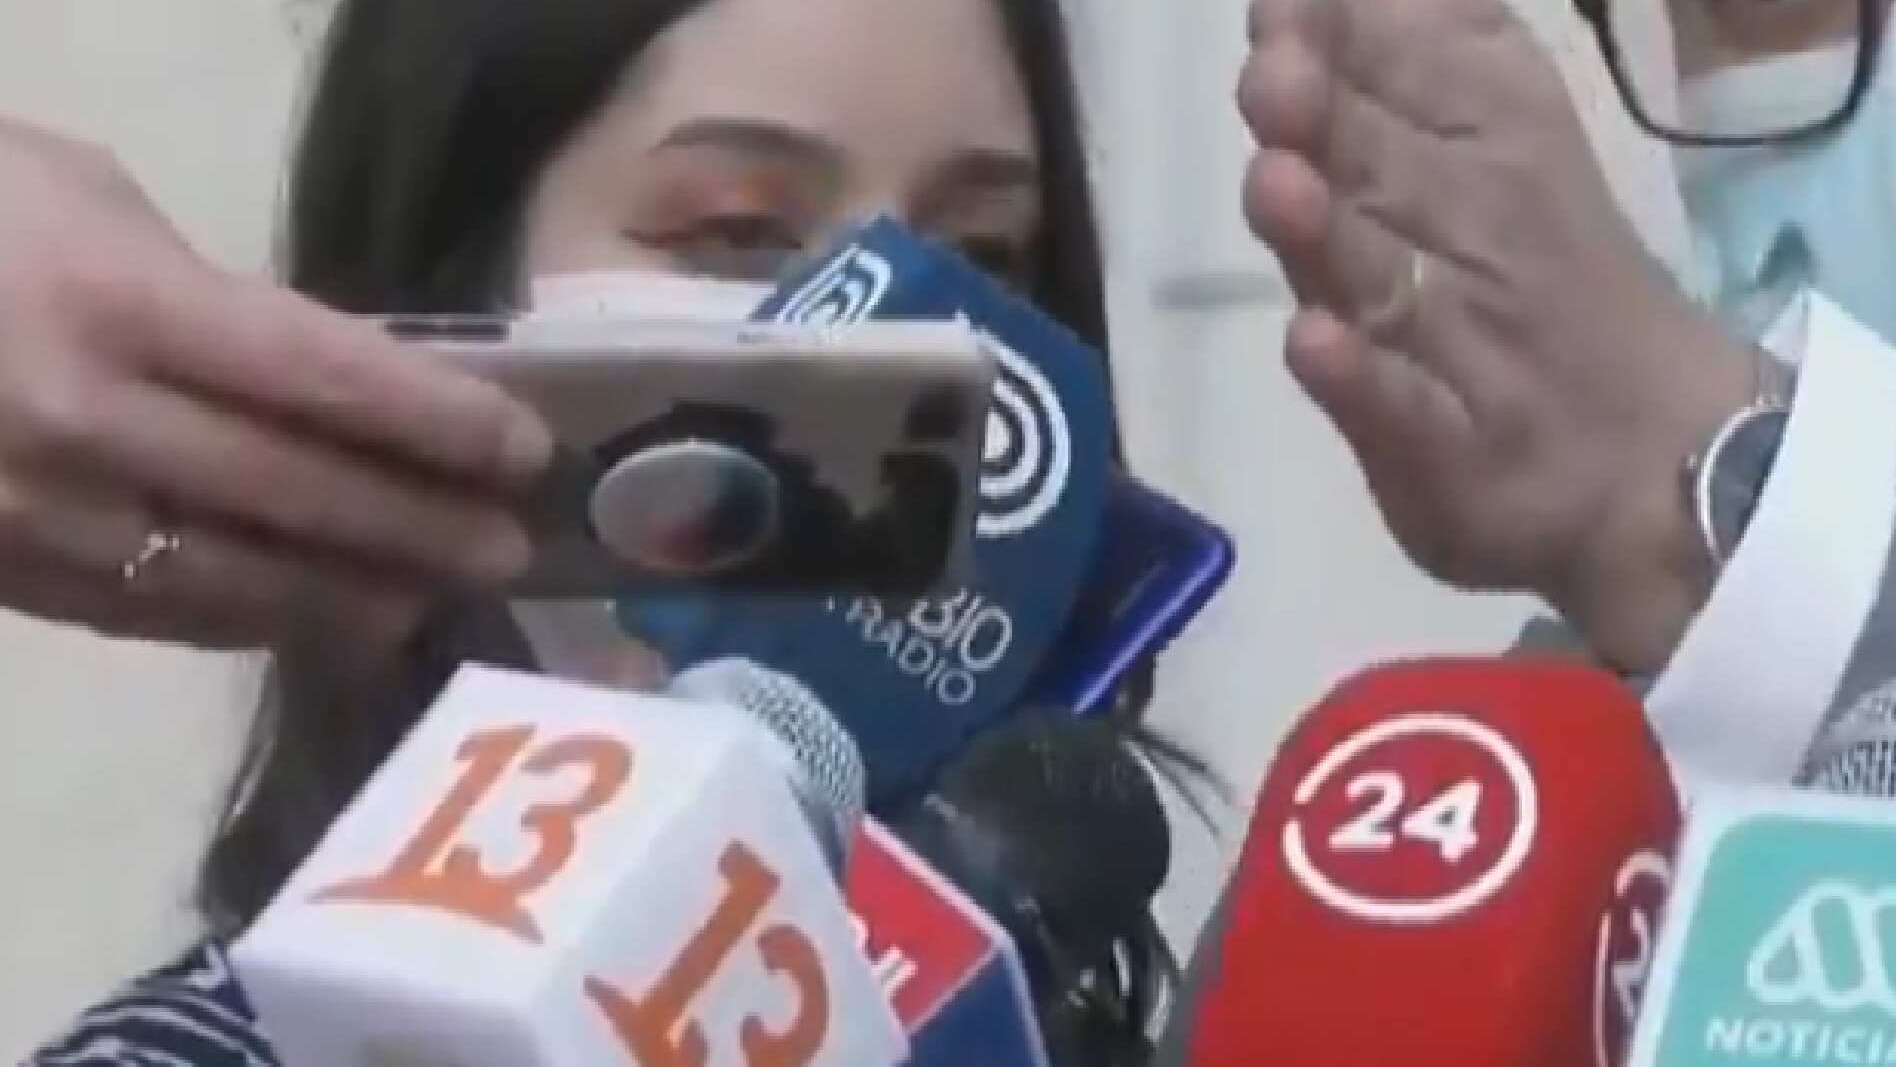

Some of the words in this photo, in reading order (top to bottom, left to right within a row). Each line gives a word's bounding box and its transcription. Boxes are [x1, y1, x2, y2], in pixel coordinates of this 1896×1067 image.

[305, 723, 634, 944] 13
[1327, 770, 1481, 864] 24
[582, 839, 830, 1067] 13
